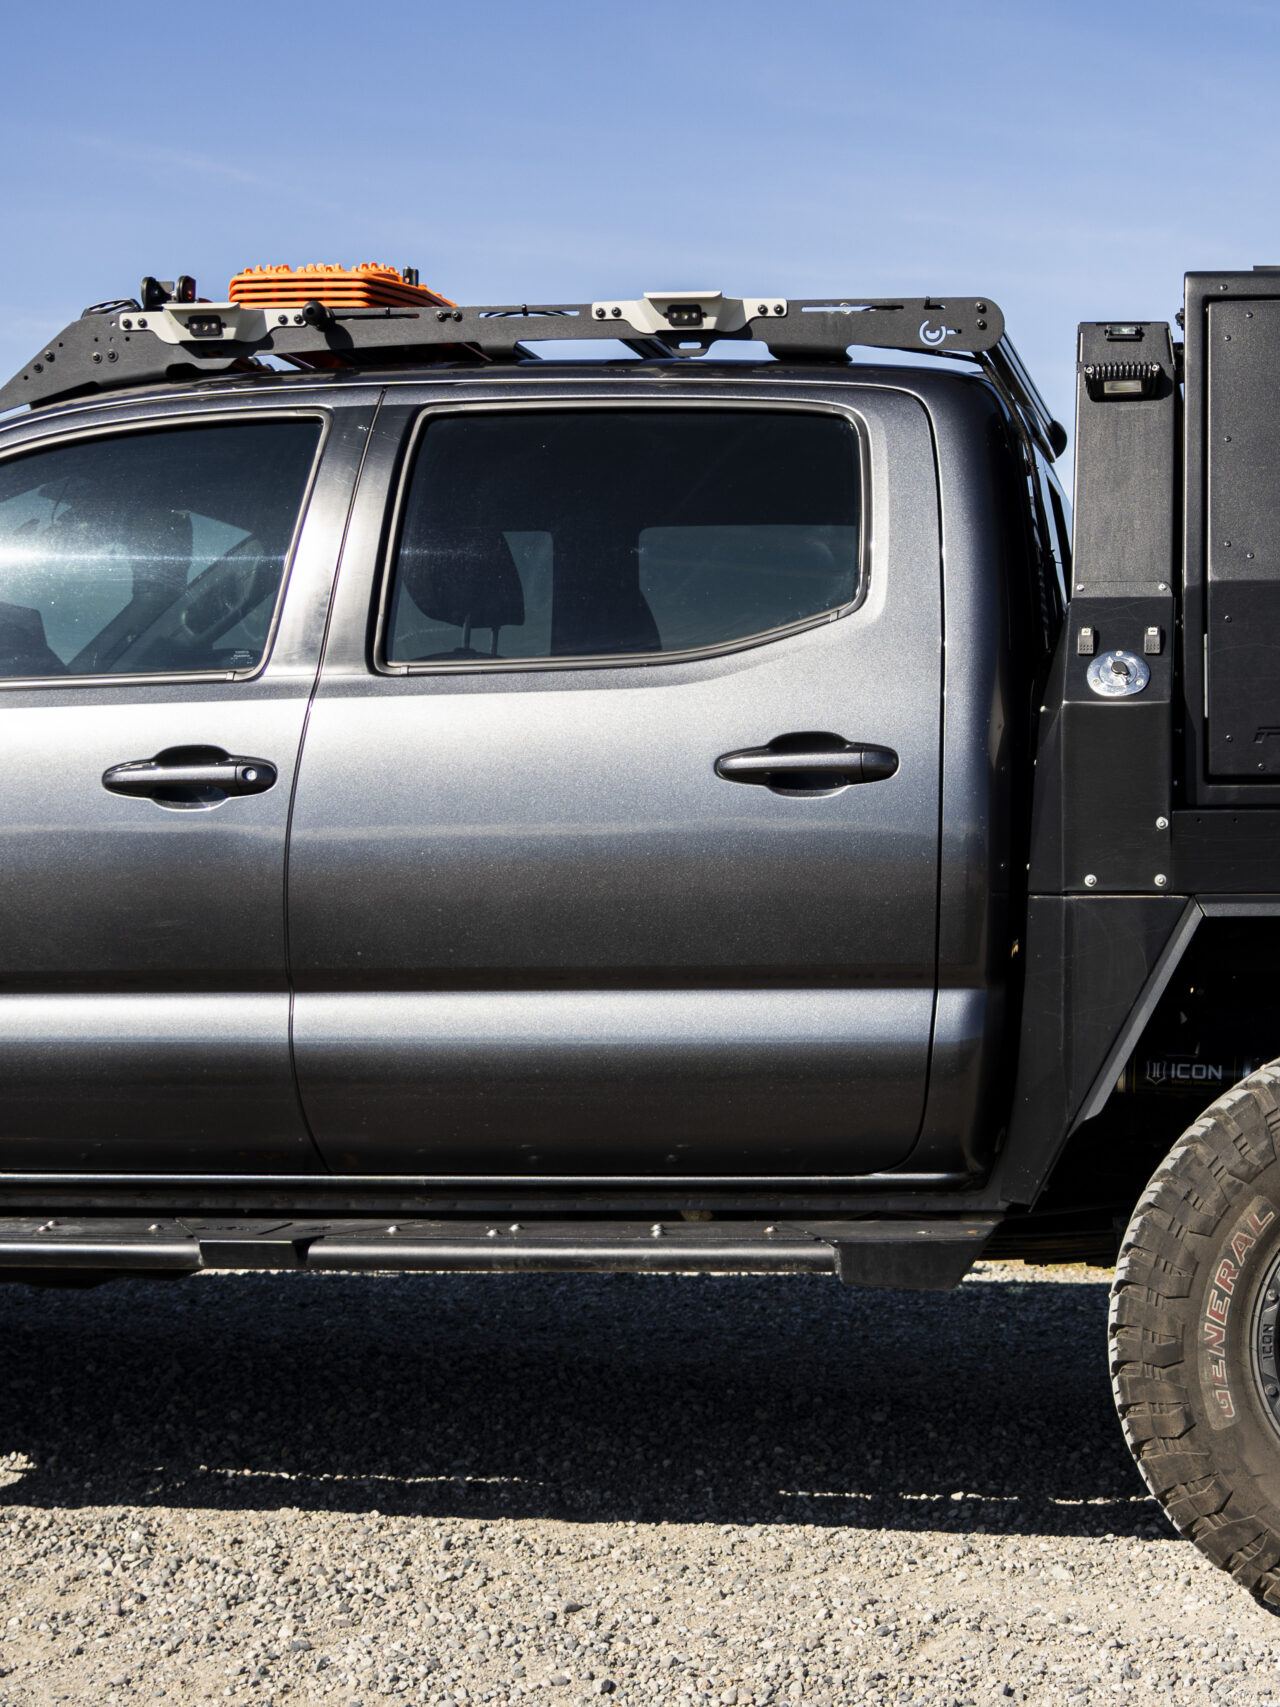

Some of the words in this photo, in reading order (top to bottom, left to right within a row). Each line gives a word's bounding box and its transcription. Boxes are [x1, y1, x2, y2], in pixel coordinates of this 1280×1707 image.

[1171, 1063, 1222, 1080] ICON
[1204, 1210, 1276, 1418] GENERAL
[1262, 1323, 1274, 1360] ICON
